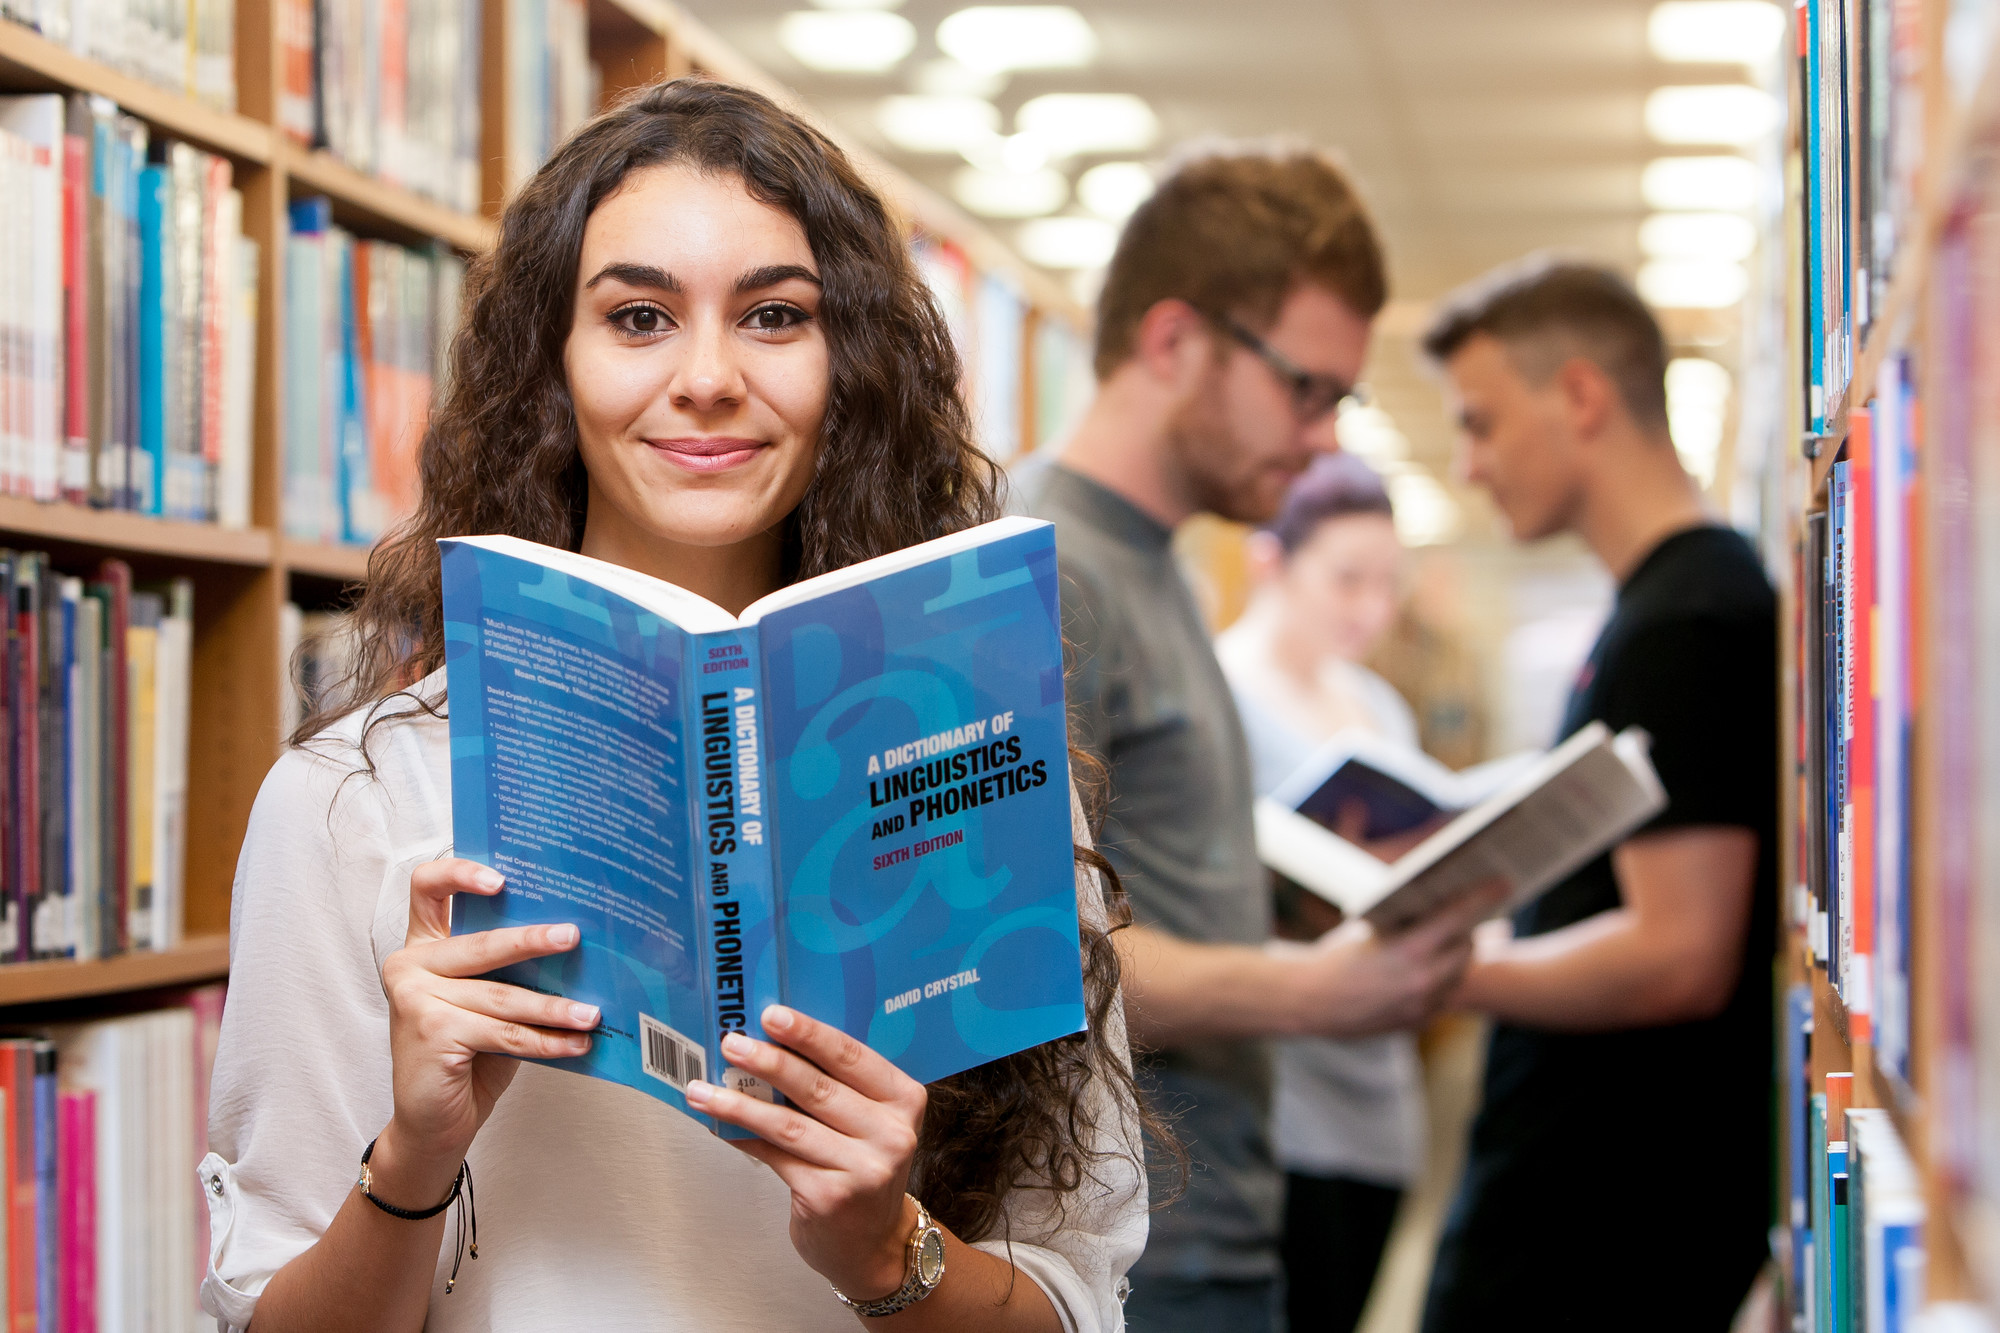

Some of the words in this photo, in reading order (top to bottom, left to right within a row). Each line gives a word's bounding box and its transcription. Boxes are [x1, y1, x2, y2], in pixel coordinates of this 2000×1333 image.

[703, 658, 749, 674] EDITION
[708, 644, 743, 660] SIXTH
[734, 687, 755, 702] A
[734, 704, 762, 816] DICTIONARY
[867, 755, 881, 776] A
[884, 720, 987, 770] DICTIONARY
[991, 711, 1014, 735] OF
[701, 691, 737, 857] LINGUISTICS
[869, 735, 1022, 808] LINGUISTICS
[871, 814, 905, 840] AND
[909, 759, 1048, 827] PHONETICS
[741, 821, 763, 846] OF
[872, 847, 910, 871] SIXTH
[914, 829, 964, 858] EDITION
[710, 861, 729, 897] AND
[884, 988, 921, 1015] DAVID
[924, 968, 981, 999] CRYSTAL
